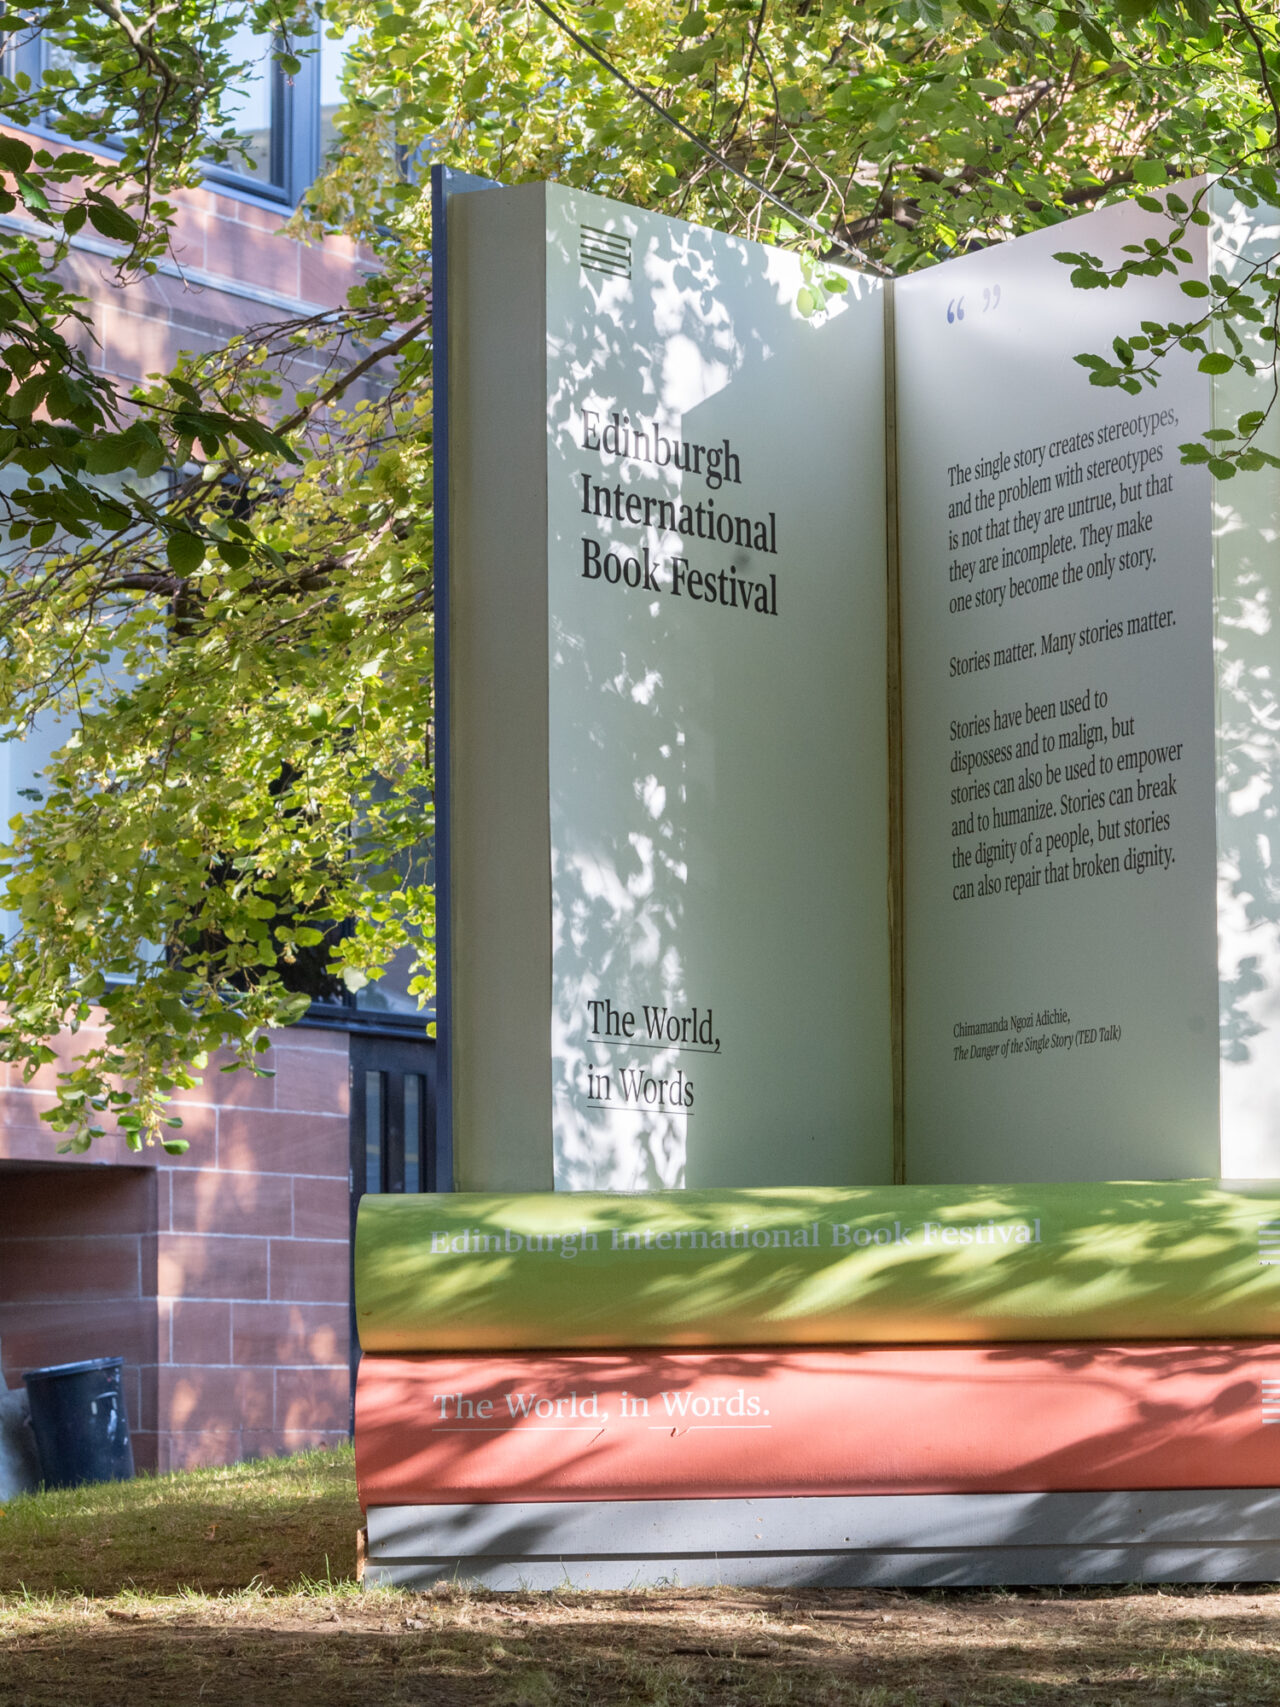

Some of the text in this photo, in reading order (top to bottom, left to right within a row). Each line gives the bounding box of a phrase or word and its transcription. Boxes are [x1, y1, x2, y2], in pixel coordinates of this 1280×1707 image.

[581, 408, 741, 490] Edinburgh
[948, 408, 1179, 487] The single story creates stereotypes,
[948, 445, 1163, 519] and the problem with stereotypes
[949, 473, 1173, 550] is not that they are untrue, but that
[581, 473, 778, 554] International
[581, 538, 778, 616] Book Festival
[949, 511, 1152, 583] they are incomplete. They make
[950, 548, 1156, 613] one story become the only story.
[950, 610, 1176, 677] Stories matter. Many stories matter.
[950, 688, 1108, 741] Stories have been used to
[951, 716, 1135, 775] dispossess and to malign, but
[951, 744, 1183, 805] stories can also be used to empower
[952, 773, 1177, 837] and to humanize. Stories can break
[952, 810, 1170, 869] the dignity of a people, but stories
[953, 844, 1175, 901] can also repair that broken dignity.
[588, 999, 720, 1052] The World,
[953, 1008, 1070, 1038] Chimamanda Ngozi Adichie,
[954, 1025, 1121, 1061] The Danger of the Single Story (TED Talk)
[588, 1064, 693, 1107] in Words
[430, 1218, 1042, 1259] Edinburgh International Book Festival
[433, 1390, 770, 1422] The World, in Words.
